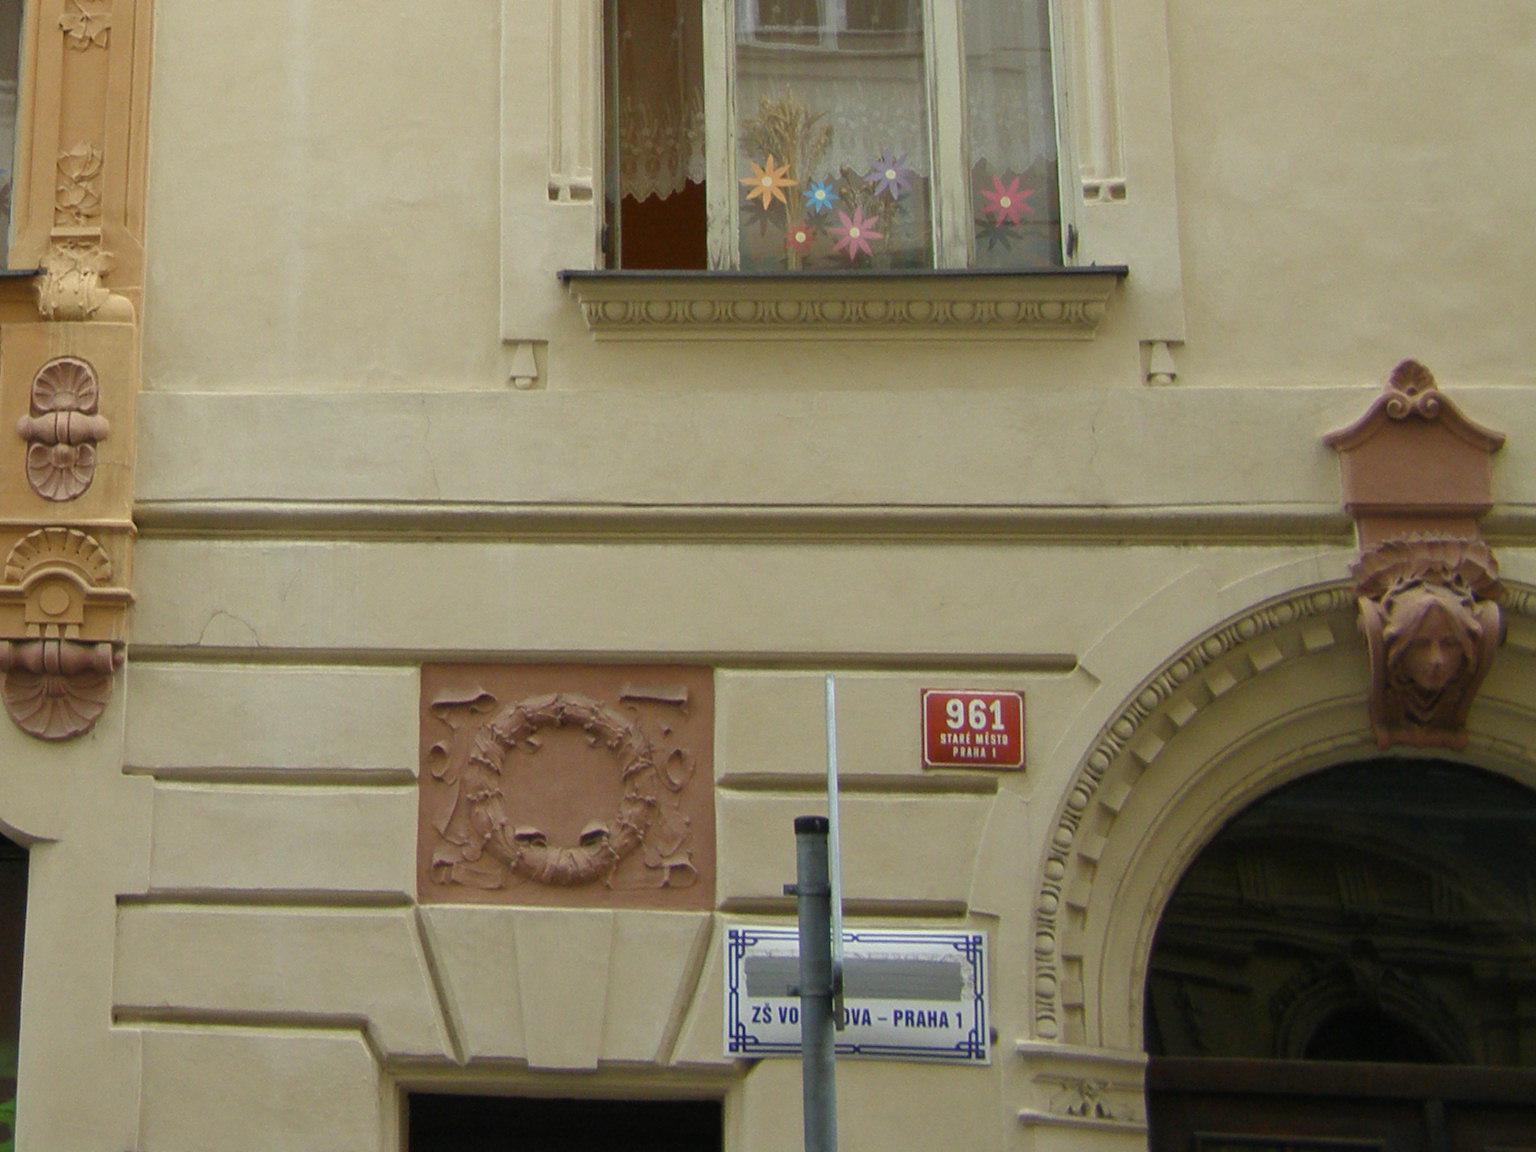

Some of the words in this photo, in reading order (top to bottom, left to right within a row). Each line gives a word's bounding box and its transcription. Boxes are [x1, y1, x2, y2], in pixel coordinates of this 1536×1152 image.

[946, 698, 1005, 730] 961
[940, 732, 971, 745] STARÉ
[952, 746, 986, 758] PRAHA
[991, 747, 997, 758] 1
[751, 1002, 772, 1024] ZŠ
[893, 1009, 949, 1029] PRAHA
[955, 1012, 963, 1029] 1
